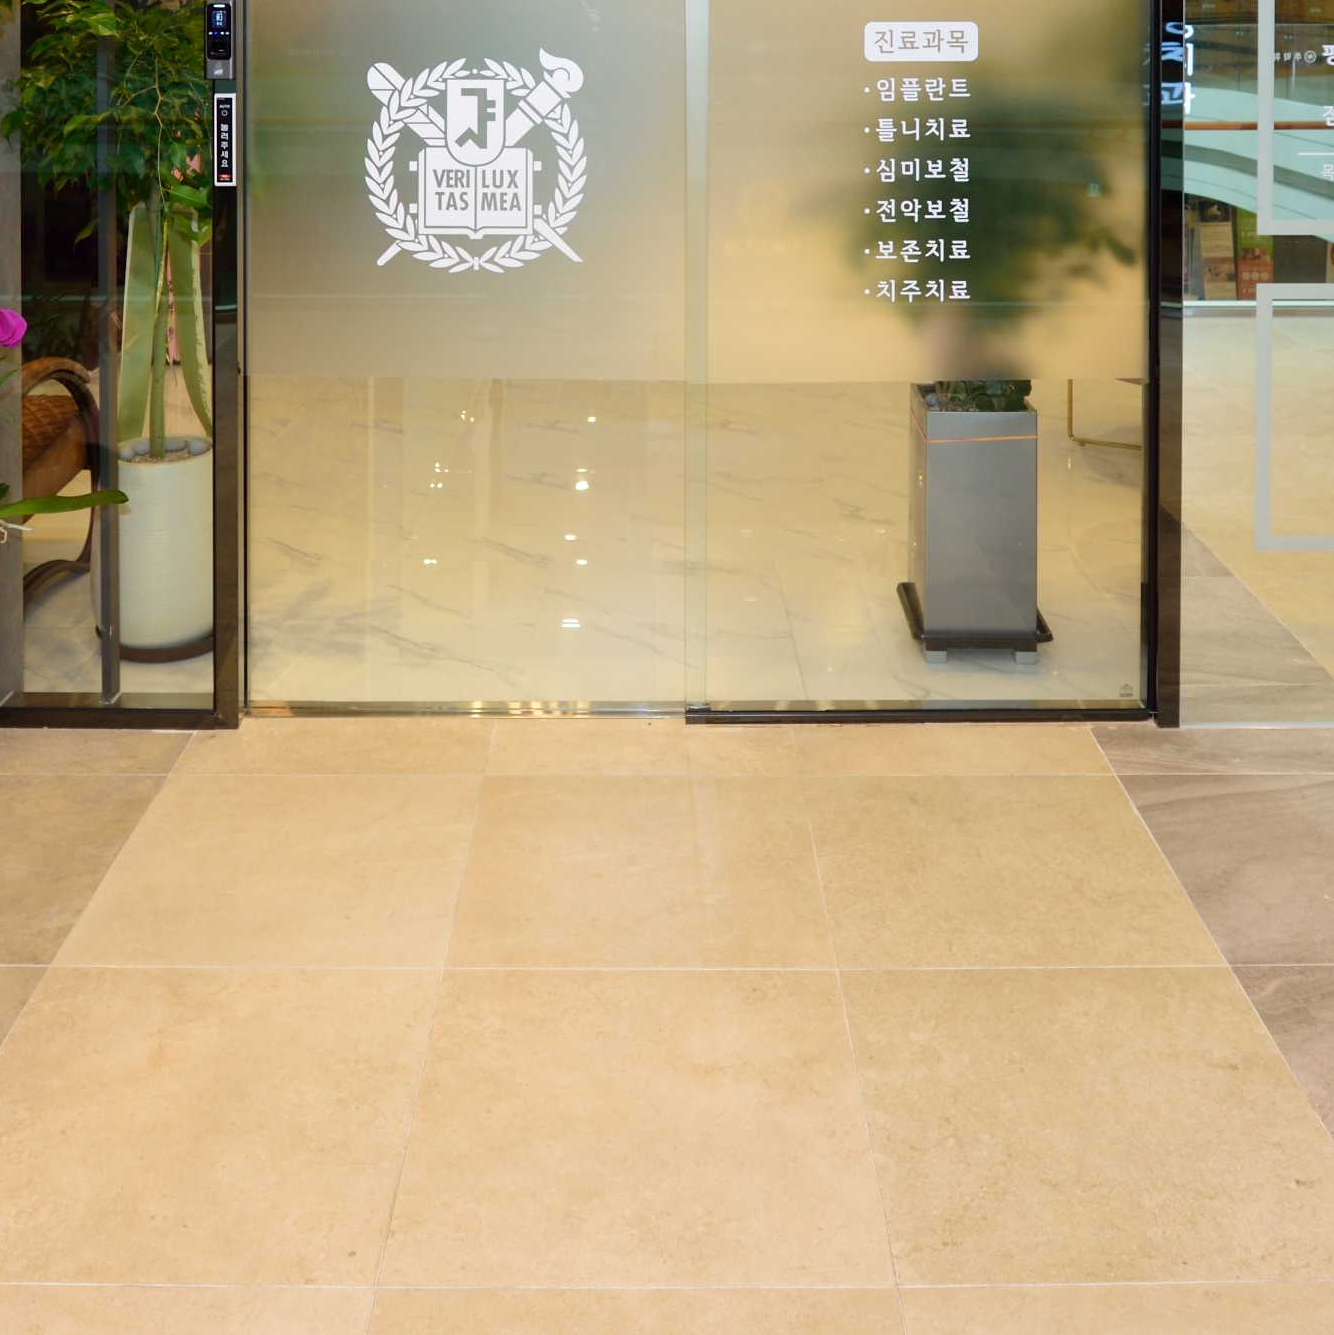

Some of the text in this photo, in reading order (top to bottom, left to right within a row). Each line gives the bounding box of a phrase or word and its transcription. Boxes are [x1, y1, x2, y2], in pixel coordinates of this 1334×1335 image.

[874, 29, 969, 54] 진료과목
[876, 77, 971, 101] 임플란트
[876, 118, 971, 142] 틀니치료
[433, 169, 470, 188] VERI
[481, 169, 519, 189] LUX
[876, 158, 970, 182] 심미보철
[435, 192, 469, 211] TAS
[480, 192, 522, 211] MEA
[876, 198, 970, 223] 전악보철
[876, 239, 971, 262] 보존치료
[876, 279, 971, 302] 치주치료
